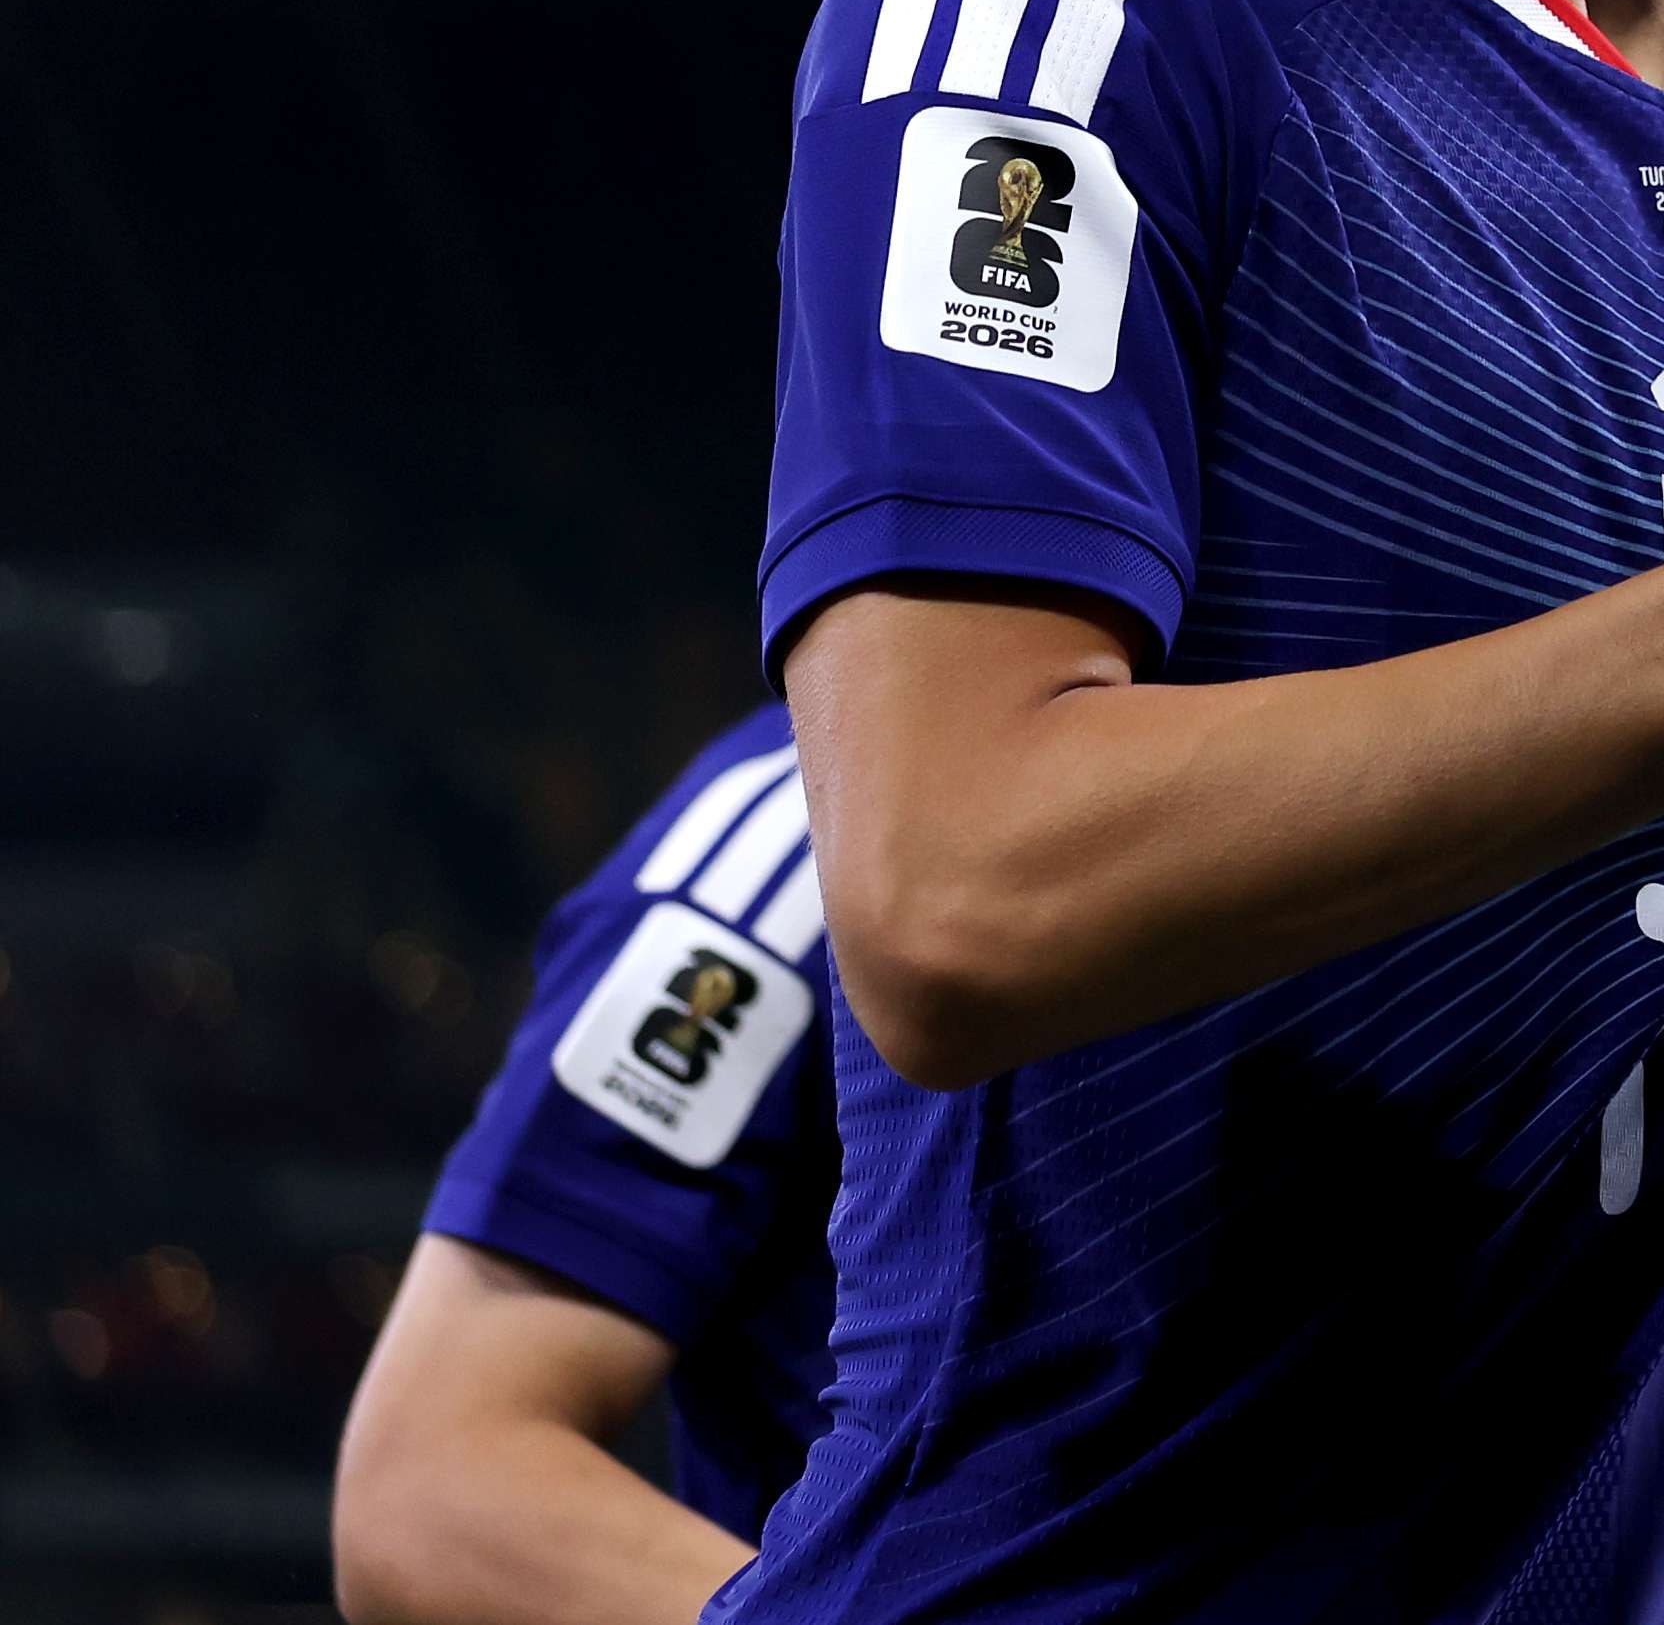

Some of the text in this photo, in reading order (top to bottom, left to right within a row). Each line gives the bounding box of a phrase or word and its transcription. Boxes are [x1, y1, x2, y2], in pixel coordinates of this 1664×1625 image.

[981, 264, 1032, 293] FIFA
[944, 301, 1056, 333] WORLD CUP
[940, 320, 1054, 359] 2026
